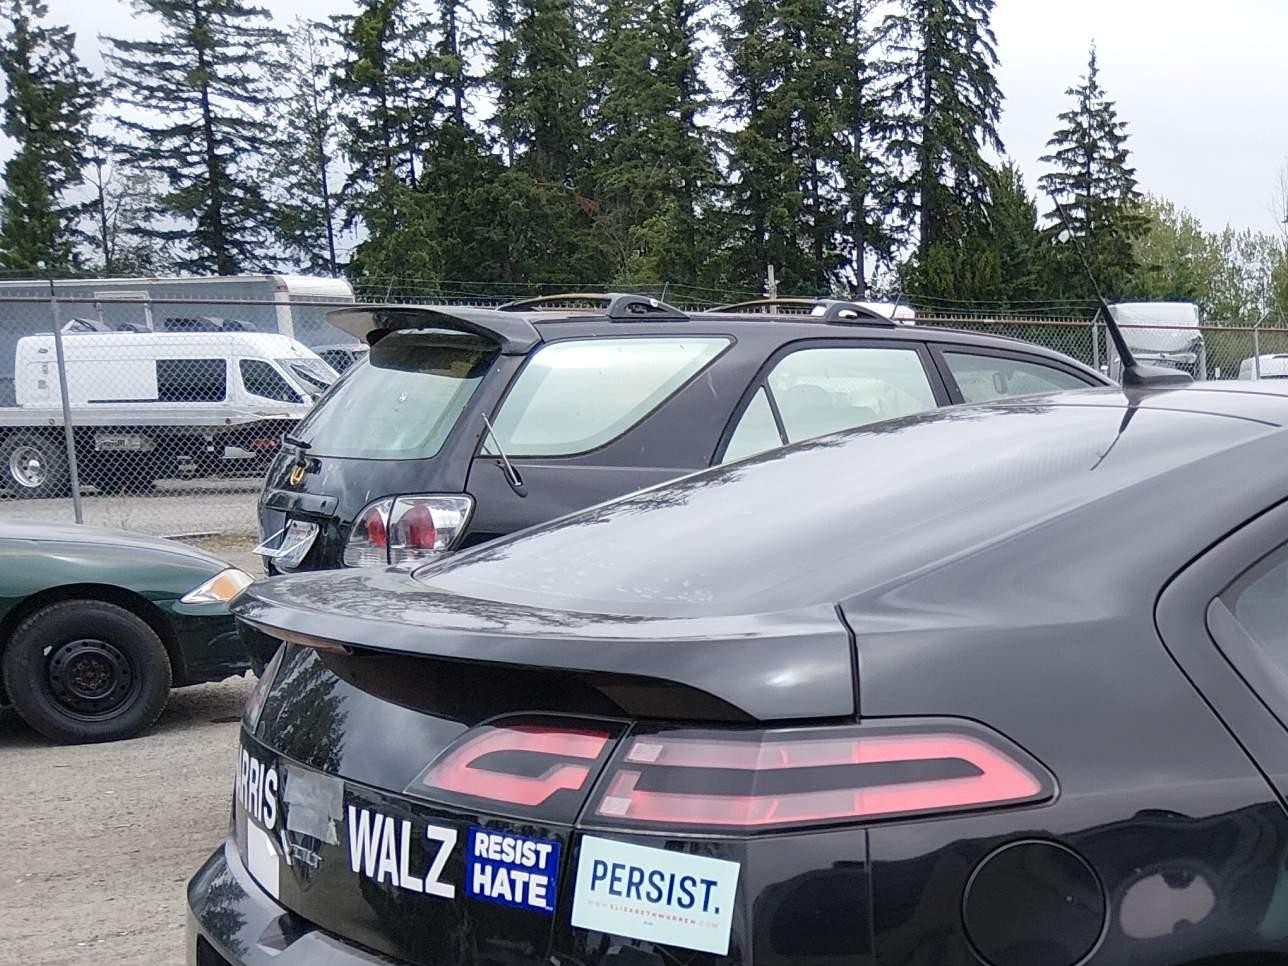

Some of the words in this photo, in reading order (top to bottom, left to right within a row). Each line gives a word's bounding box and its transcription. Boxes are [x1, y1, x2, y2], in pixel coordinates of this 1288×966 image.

[348, 805, 458, 899] WALZ
[474, 832, 552, 869] RESIST
[473, 863, 549, 908] HATE
[590, 859, 720, 915] PERSIST.
